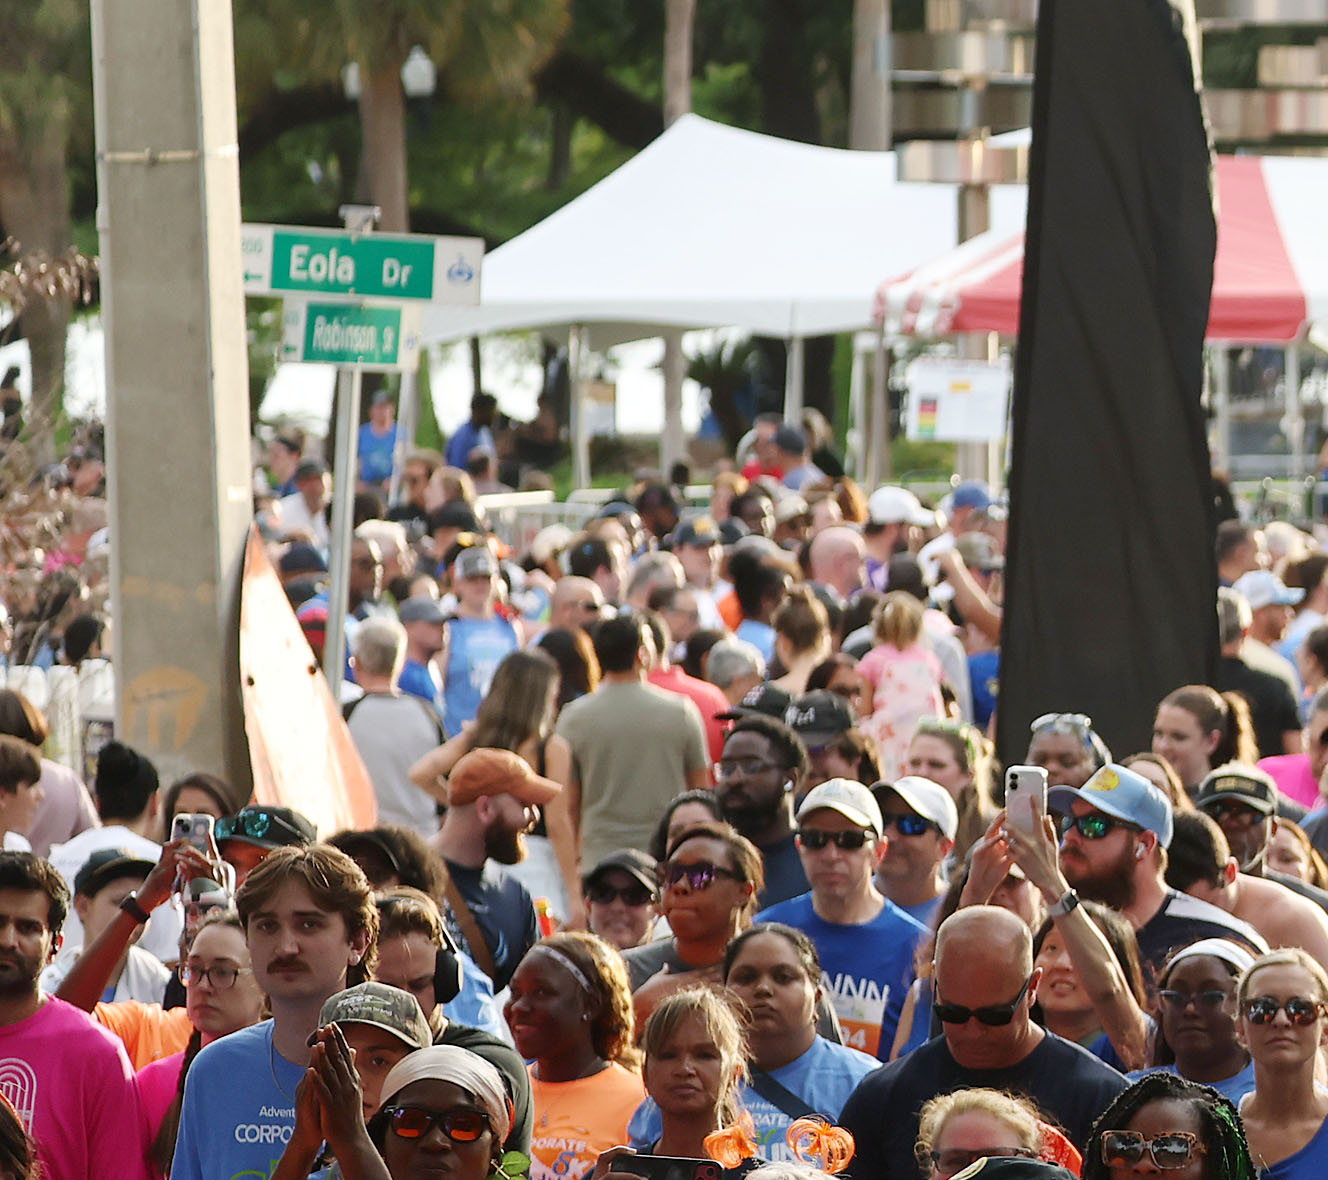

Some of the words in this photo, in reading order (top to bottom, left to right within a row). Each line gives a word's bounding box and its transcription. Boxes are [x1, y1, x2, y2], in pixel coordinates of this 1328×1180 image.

[290, 244, 355, 284] Eola
[382, 257, 413, 288] Dr
[312, 314, 377, 352] Robinson
[259, 1105, 297, 1120] Advent
[234, 1124, 296, 1143] CORPO
[530, 1137, 588, 1154] PORATE
